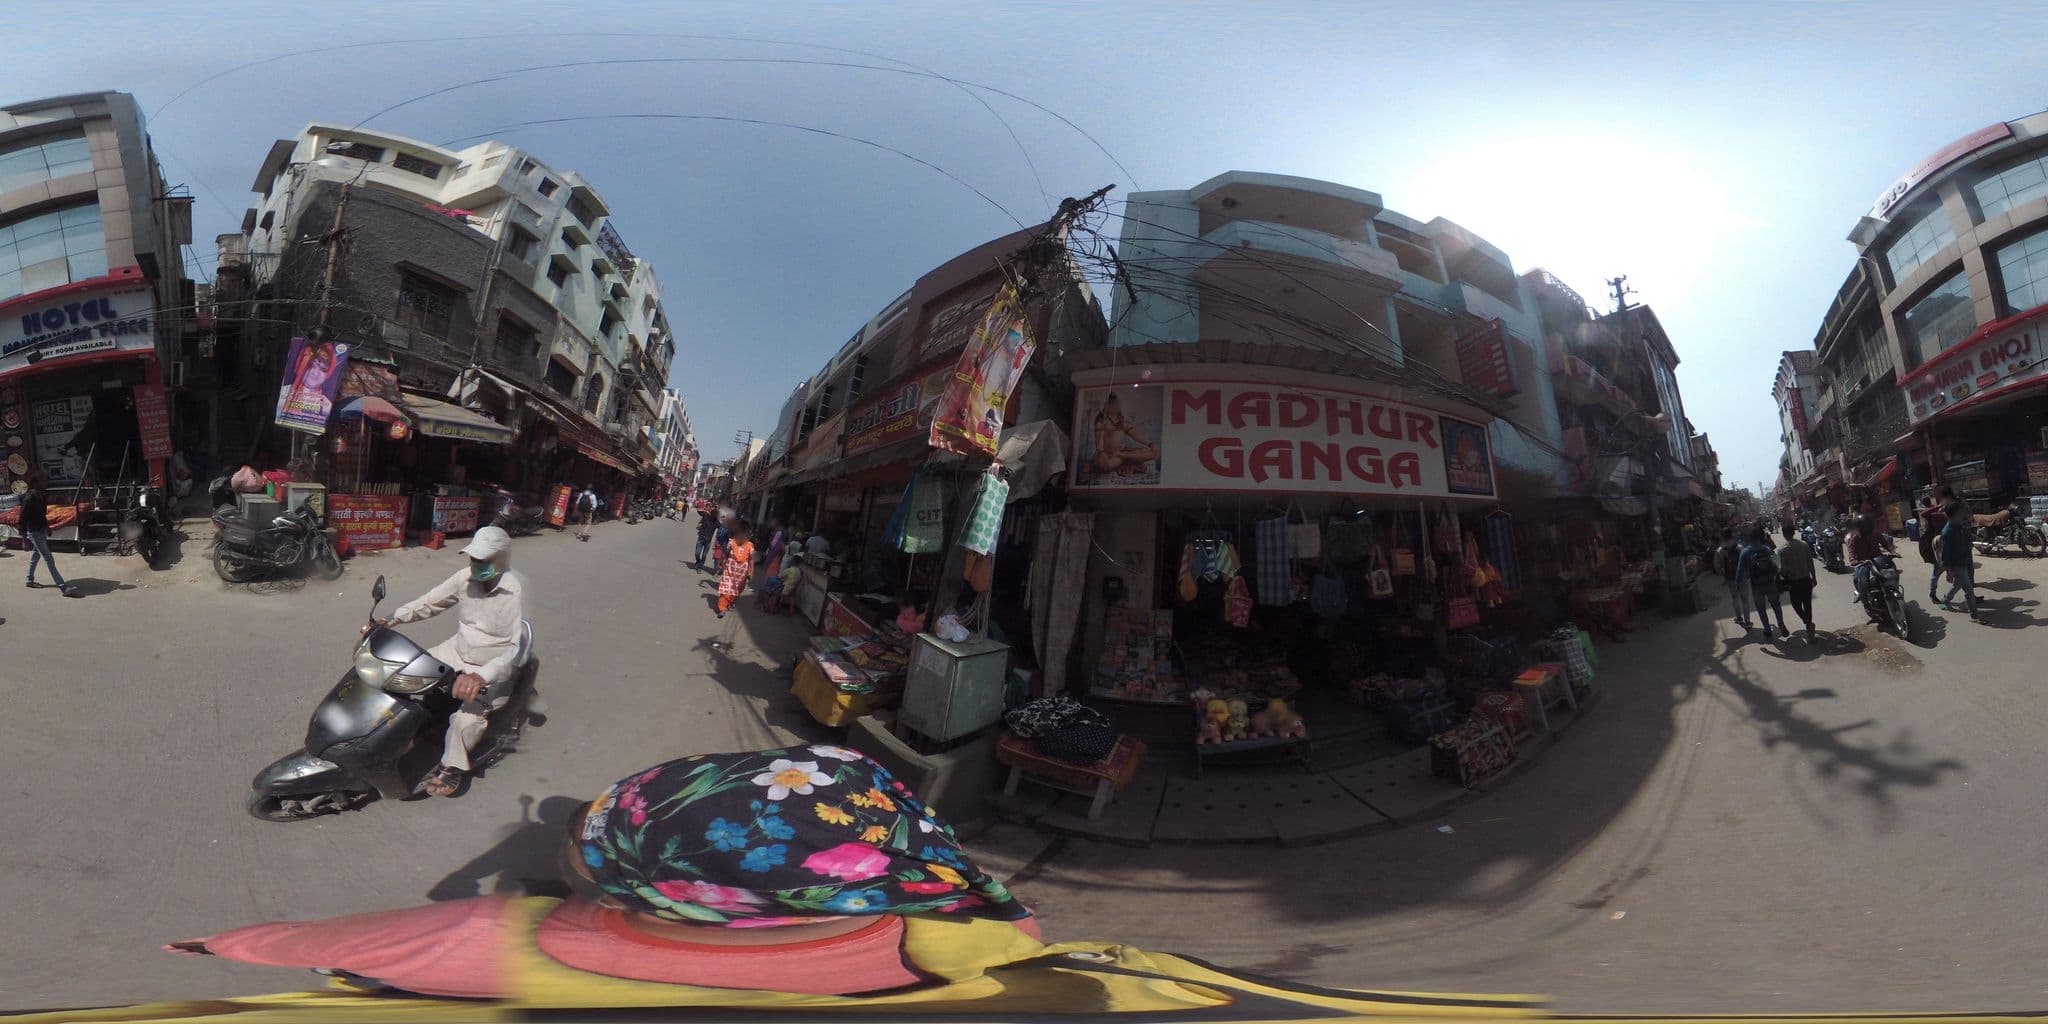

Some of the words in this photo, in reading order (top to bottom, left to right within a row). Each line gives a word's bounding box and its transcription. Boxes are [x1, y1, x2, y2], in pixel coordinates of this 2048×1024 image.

[1879, 182, 1908, 209] OYO
[22, 297, 117, 335] HOTEL
[55, 346, 75, 355] ROOM
[75, 340, 113, 351] AVAILABLE
[1980, 333, 2032, 370] BHOJ
[1171, 389, 1438, 448] MADHUR
[1198, 437, 1421, 488] GANGA
